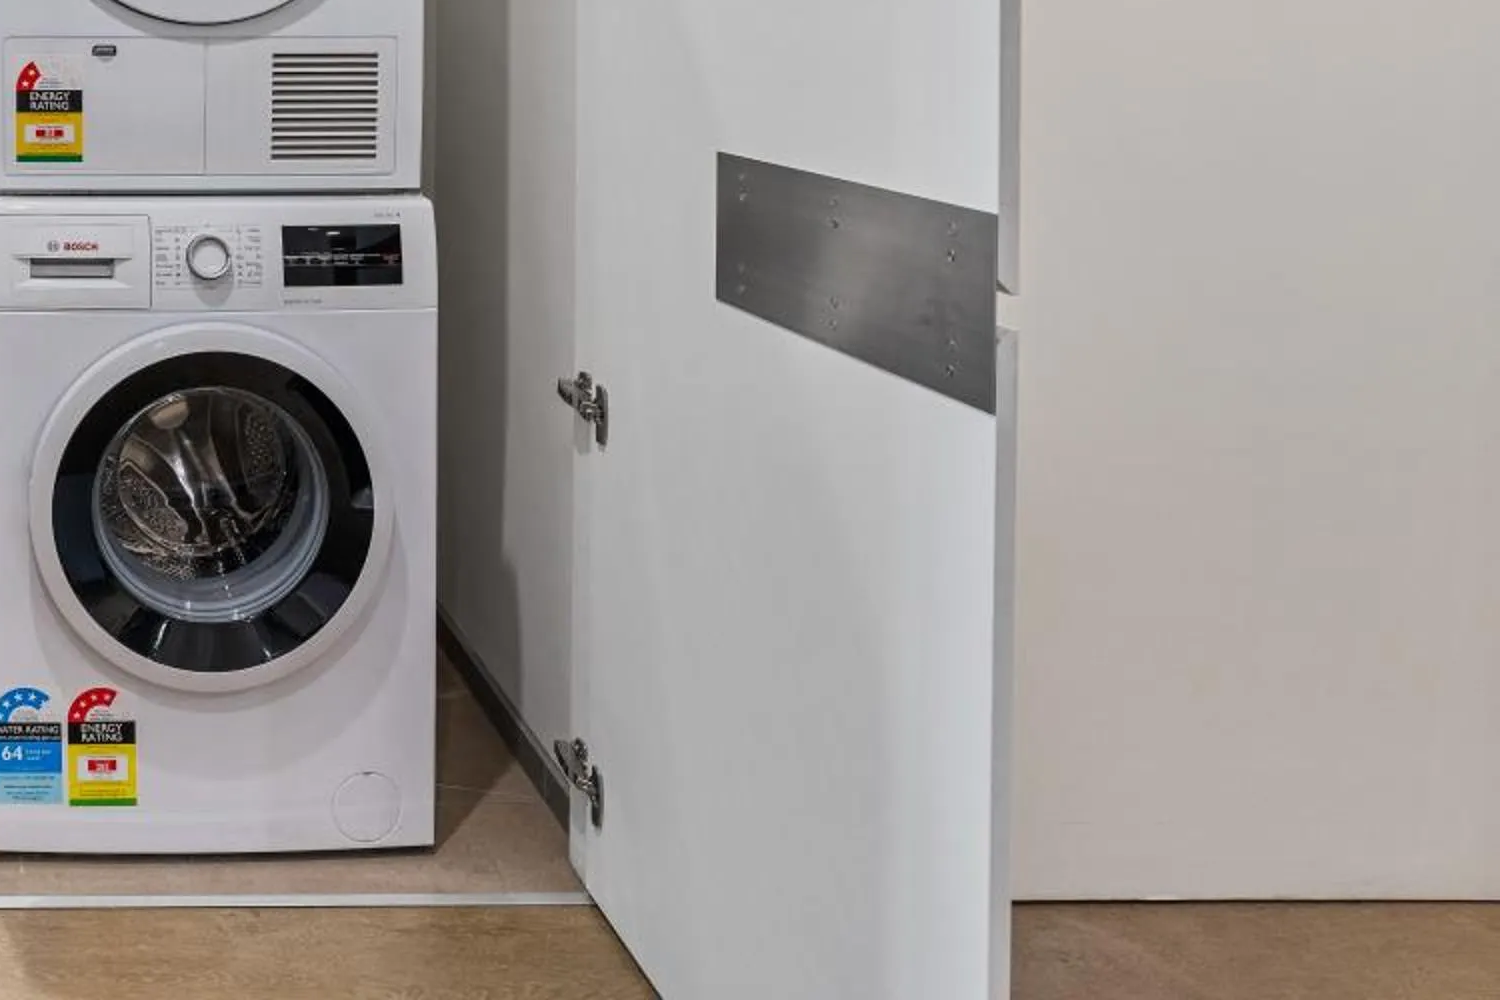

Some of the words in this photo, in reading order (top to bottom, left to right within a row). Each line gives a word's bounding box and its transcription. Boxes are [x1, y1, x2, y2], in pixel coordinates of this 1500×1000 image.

[29, 91, 71, 101] ENERGY
[29, 101, 69, 111] RATING
[63, 241, 99, 251] BOSCH
[25, 725, 59, 734] RATING
[80, 723, 123, 733] ENERGY
[81, 733, 124, 743] RATING
[1, 745, 23, 761] 64
